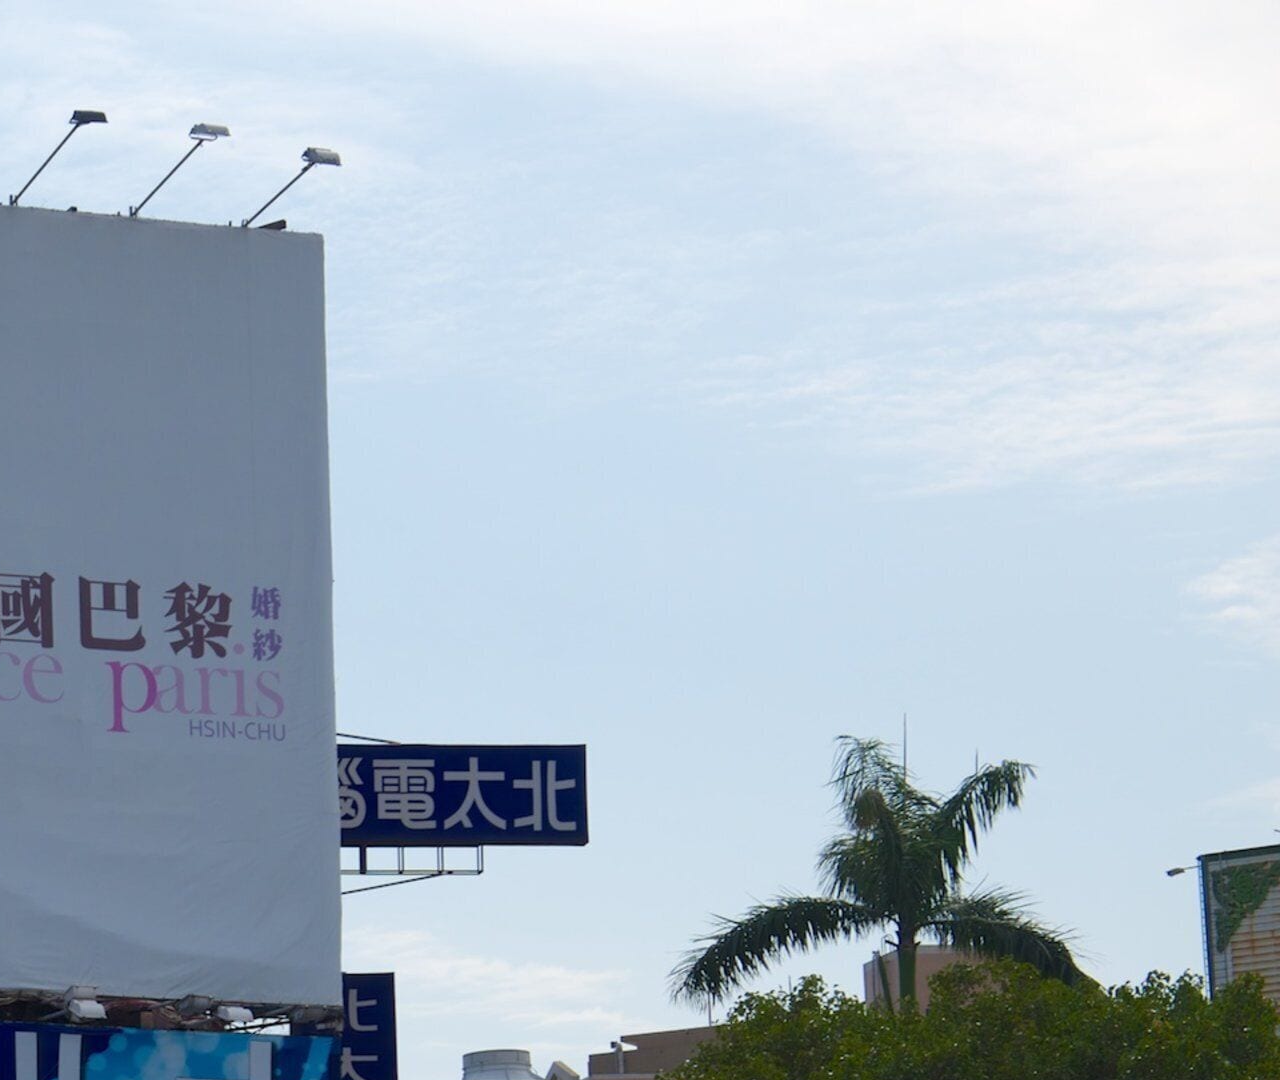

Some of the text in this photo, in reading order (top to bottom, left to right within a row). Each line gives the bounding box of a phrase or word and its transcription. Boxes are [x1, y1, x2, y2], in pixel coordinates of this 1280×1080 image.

[251, 585, 282, 662] 婚紗
[105, 643, 285, 733] paris
[189, 719, 287, 742] HSIN-CHU
